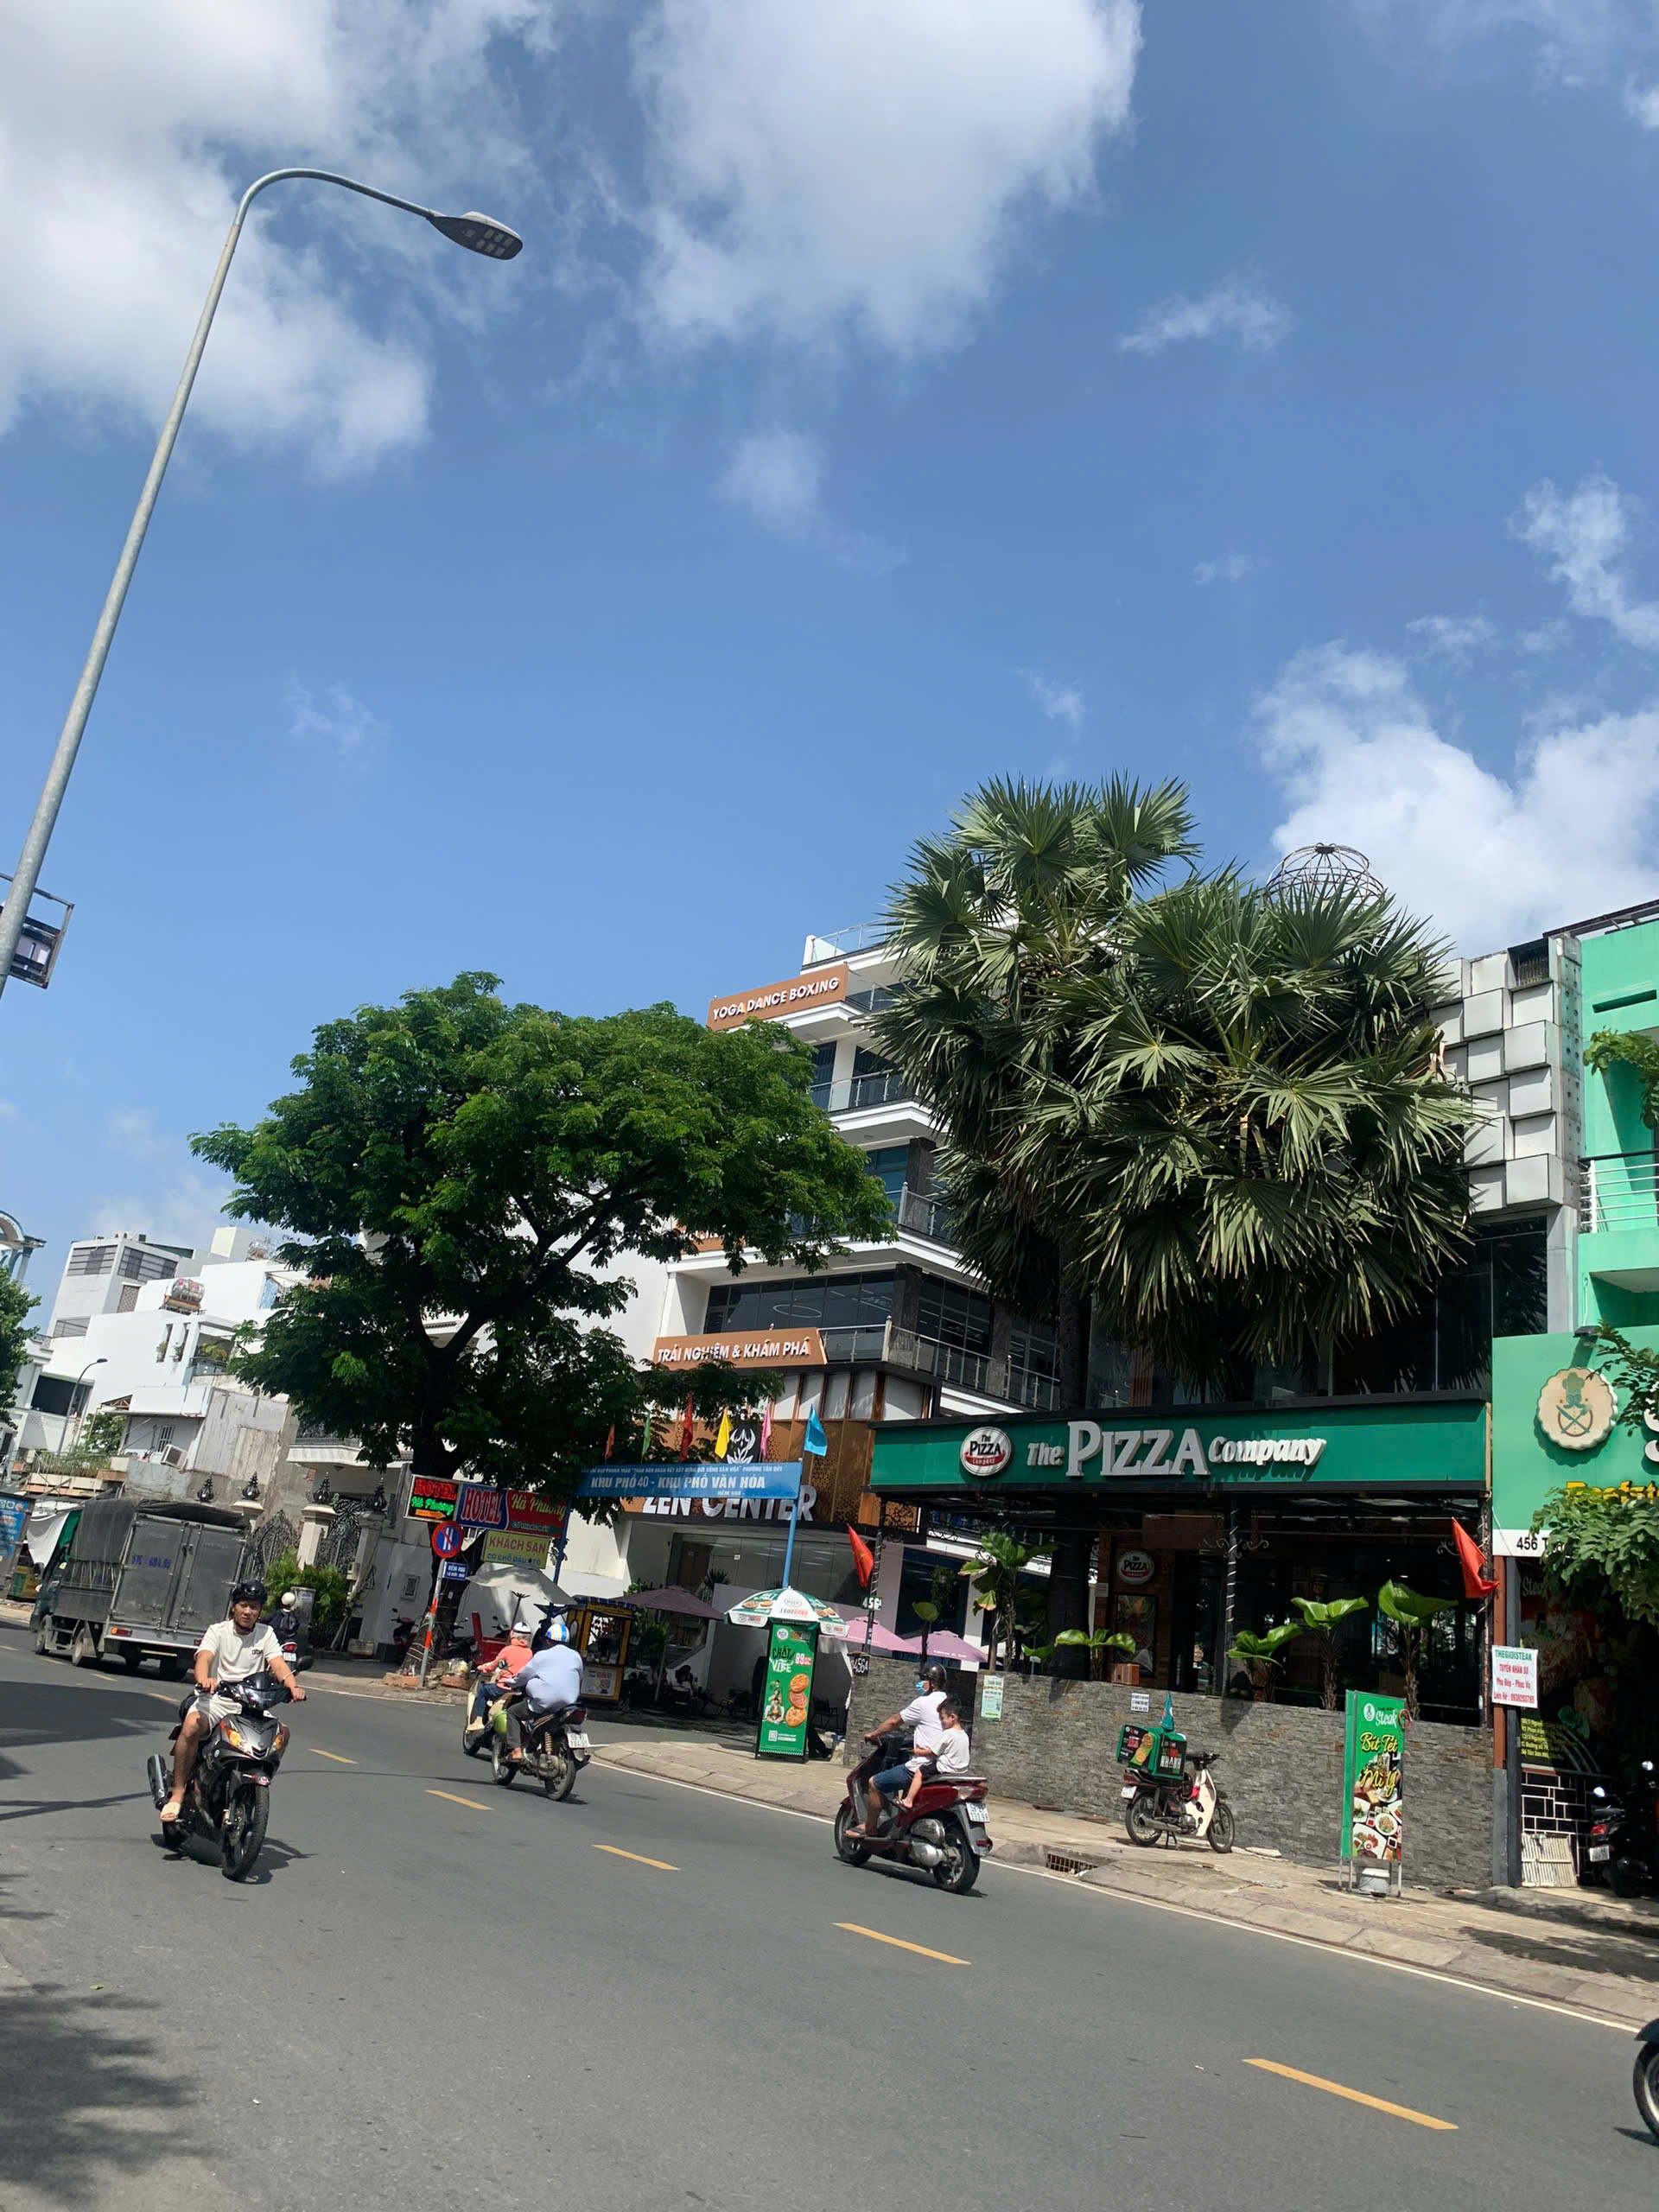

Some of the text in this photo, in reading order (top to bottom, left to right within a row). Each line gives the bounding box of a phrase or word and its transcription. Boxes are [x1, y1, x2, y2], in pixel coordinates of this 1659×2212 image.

[713, 976, 840, 1020] YOGA DANCE BOXING
[658, 1344, 682, 1362] TRẢI
[732, 1344, 741, 1358] &
[782, 1336, 812, 1356] PHÁ
[969, 1440, 1001, 1456] PIZZA
[1027, 1421, 1327, 1477] The PIZZA Company
[591, 1477, 613, 1488] KHU
[615, 1473, 637, 1488] PHỐ
[658, 1477, 681, 1488] KHU
[683, 1472, 708, 1489] PHỐ
[711, 1473, 736, 1489] VĂN
[739, 1473, 766, 1489] HÓA
[461, 1487, 503, 1524] HOTEL
[512, 1493, 527, 1510] Hà
[489, 1535, 524, 1551] KHÁCH
[1516, 1536, 1538, 1551] 456
[1375, 1708, 1397, 1728] Steak
